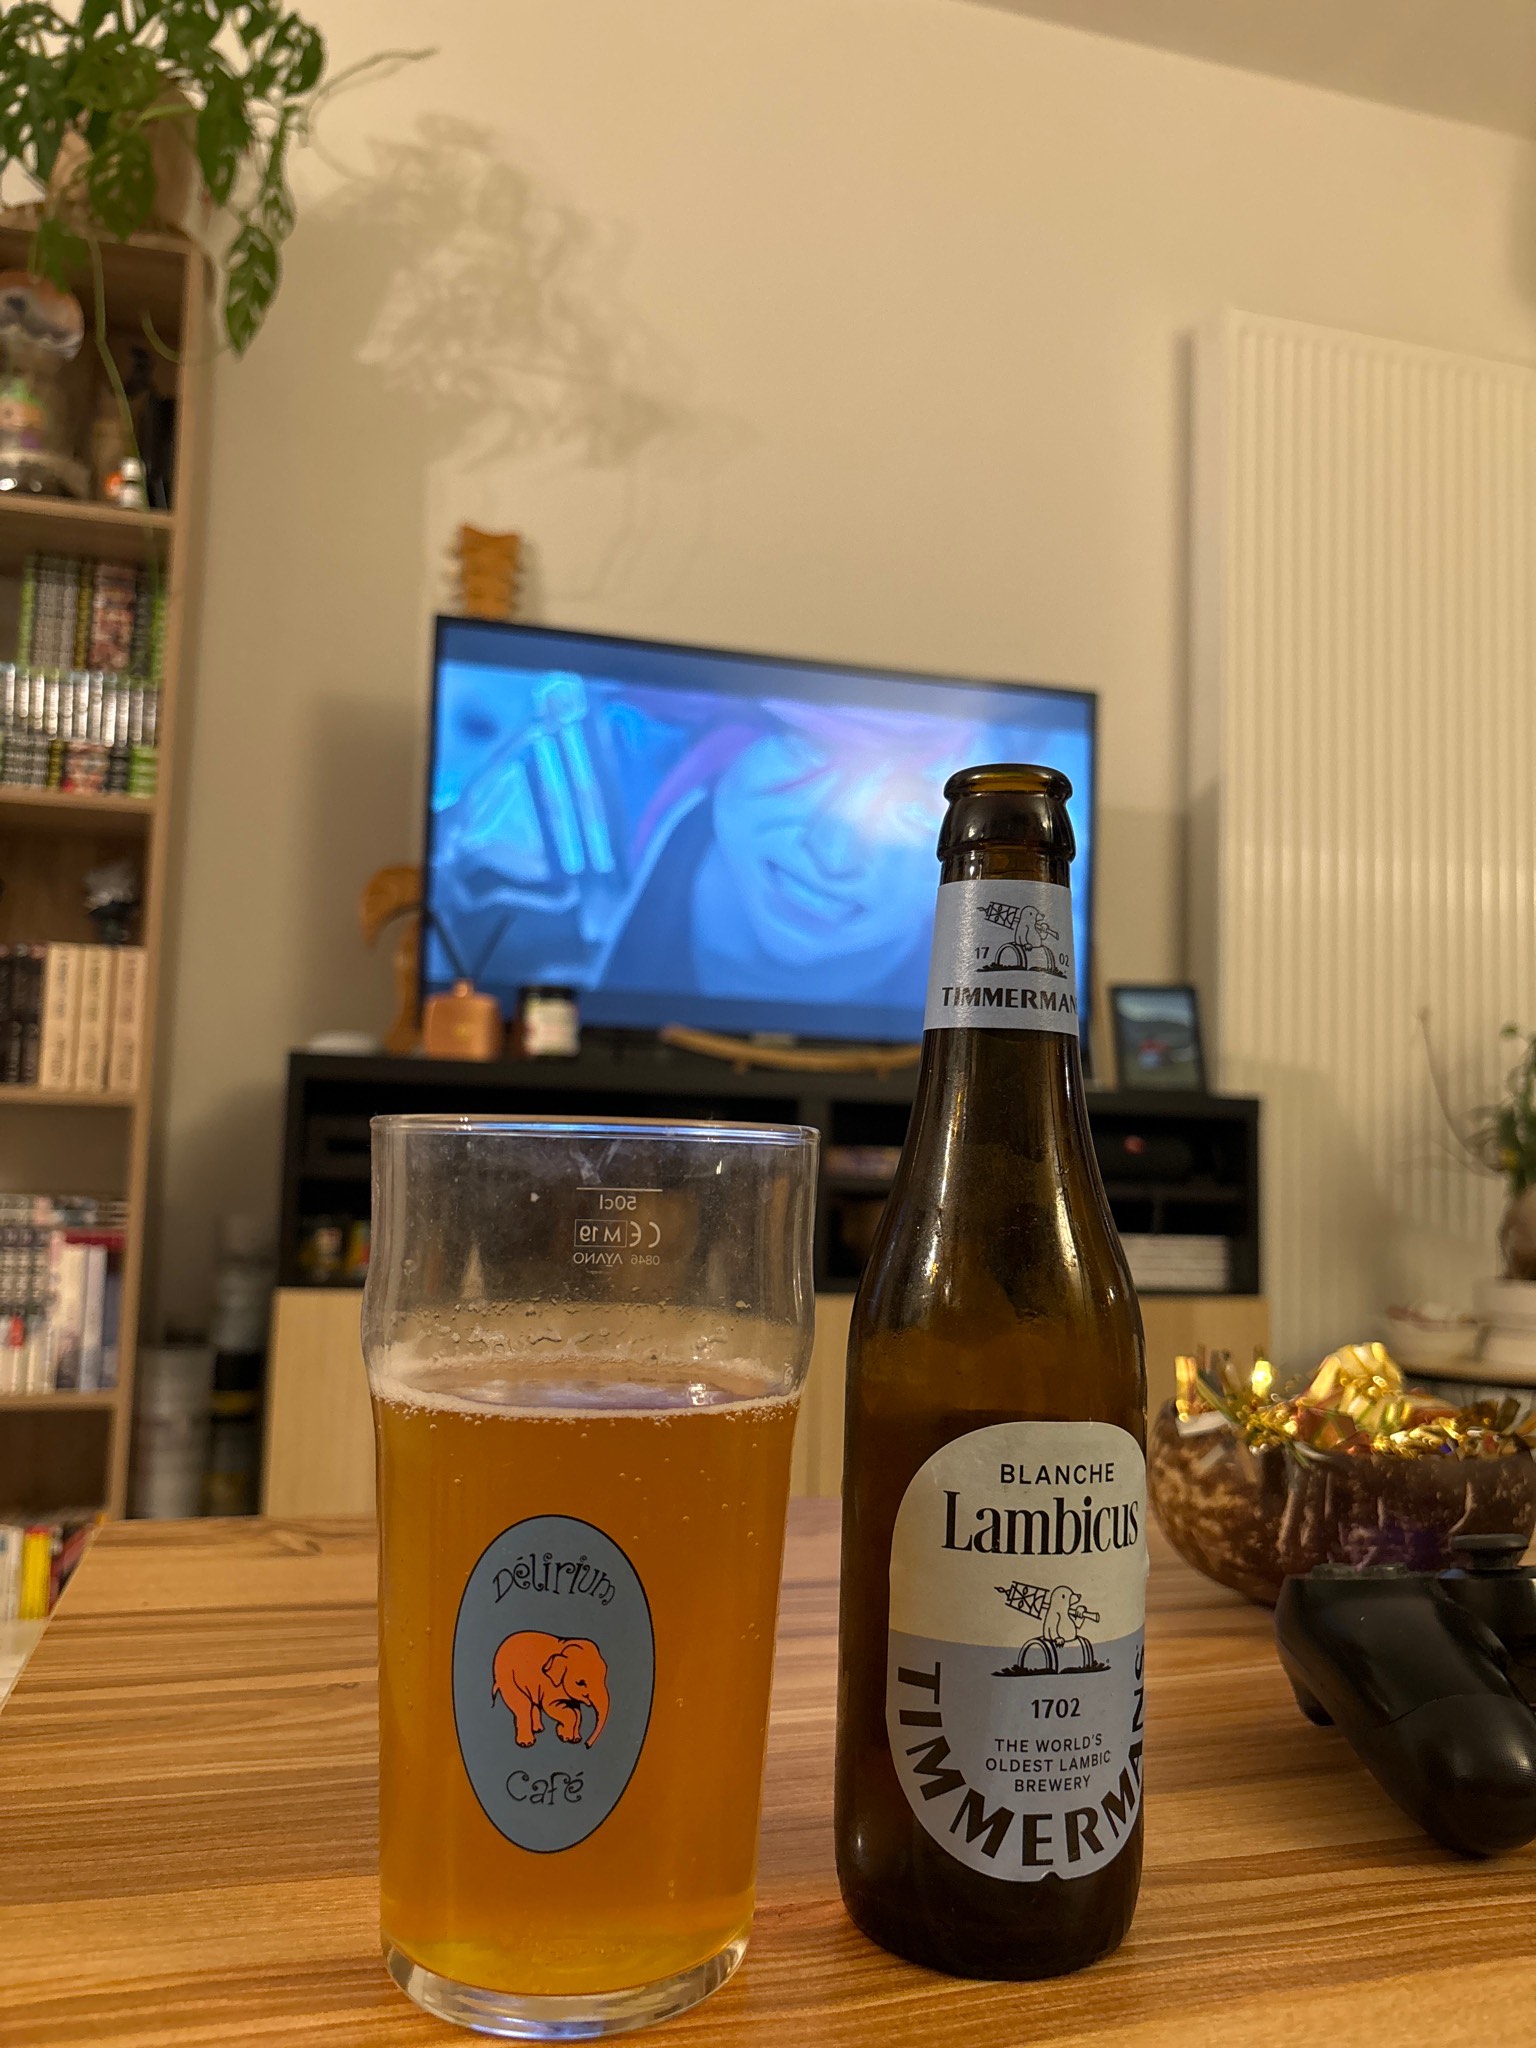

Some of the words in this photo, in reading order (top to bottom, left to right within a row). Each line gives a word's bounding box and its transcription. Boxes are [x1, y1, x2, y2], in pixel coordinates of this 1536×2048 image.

[974, 946, 990, 960] 17
[1058, 953, 1070, 968] 02
[1000, 1462, 1115, 1485] BLANCHE
[941, 1489, 1139, 1555] Lambicus
[492, 1552, 616, 1606] Délirium
[1031, 1697, 1081, 1719] 1702
[994, 1738, 1029, 1753] THE
[1035, 1733, 1103, 1753] WORLD'S
[985, 1756, 1054, 1773] OLDEST
[1058, 1750, 1112, 1772] LAMBIC
[505, 1769, 585, 1806] Café
[1014, 1775, 1091, 1793] BREWERY
